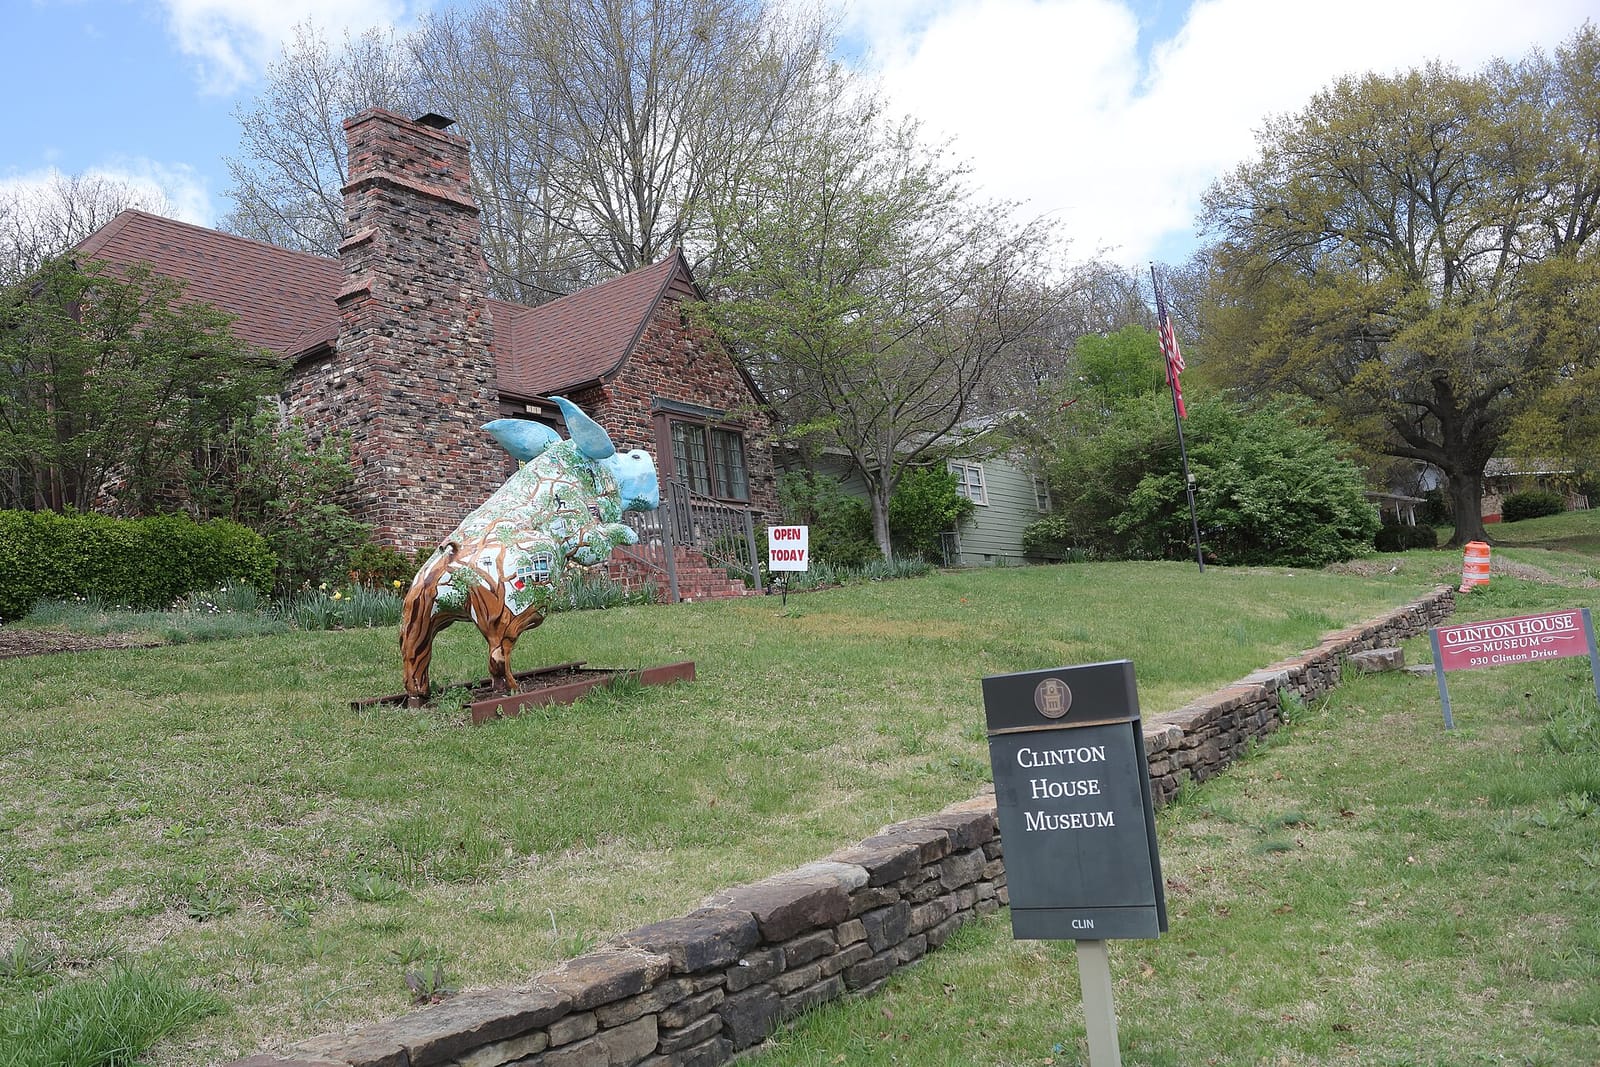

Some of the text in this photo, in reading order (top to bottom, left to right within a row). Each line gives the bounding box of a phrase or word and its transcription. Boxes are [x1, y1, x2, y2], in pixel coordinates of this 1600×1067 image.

[774, 528, 801, 541] OPEN
[770, 549, 805, 561] TODAY
[1446, 615, 1574, 644] CLINTON HOUSE
[1483, 637, 1540, 653] MUSEUM
[1470, 649, 1558, 666] 930 Clinton Drive
[1017, 745, 1106, 768] CLINTON
[1030, 778, 1101, 800] HOUSE
[1024, 810, 1115, 832] MUSEUM
[1071, 919, 1095, 929] CLIN
